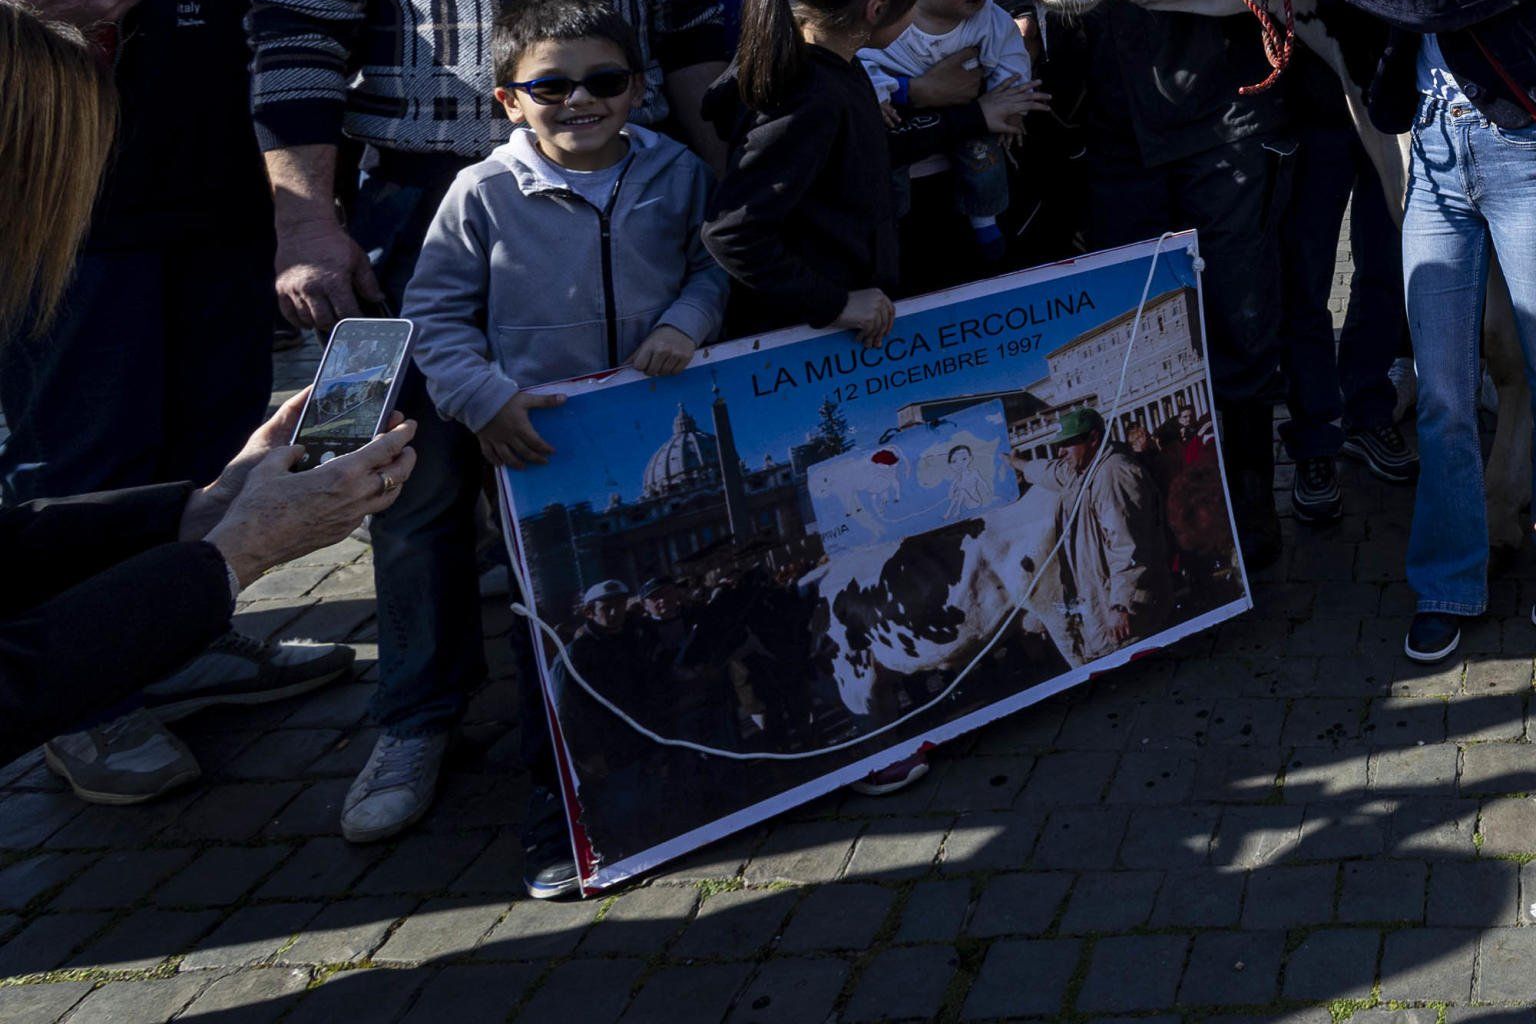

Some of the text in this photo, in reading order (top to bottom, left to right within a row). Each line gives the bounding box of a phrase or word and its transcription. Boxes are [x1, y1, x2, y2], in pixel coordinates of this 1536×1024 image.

[751, 290, 1096, 397] LA MUCCA ERCOLINA
[833, 334, 1043, 403] 12 DICEMBRE 1997
